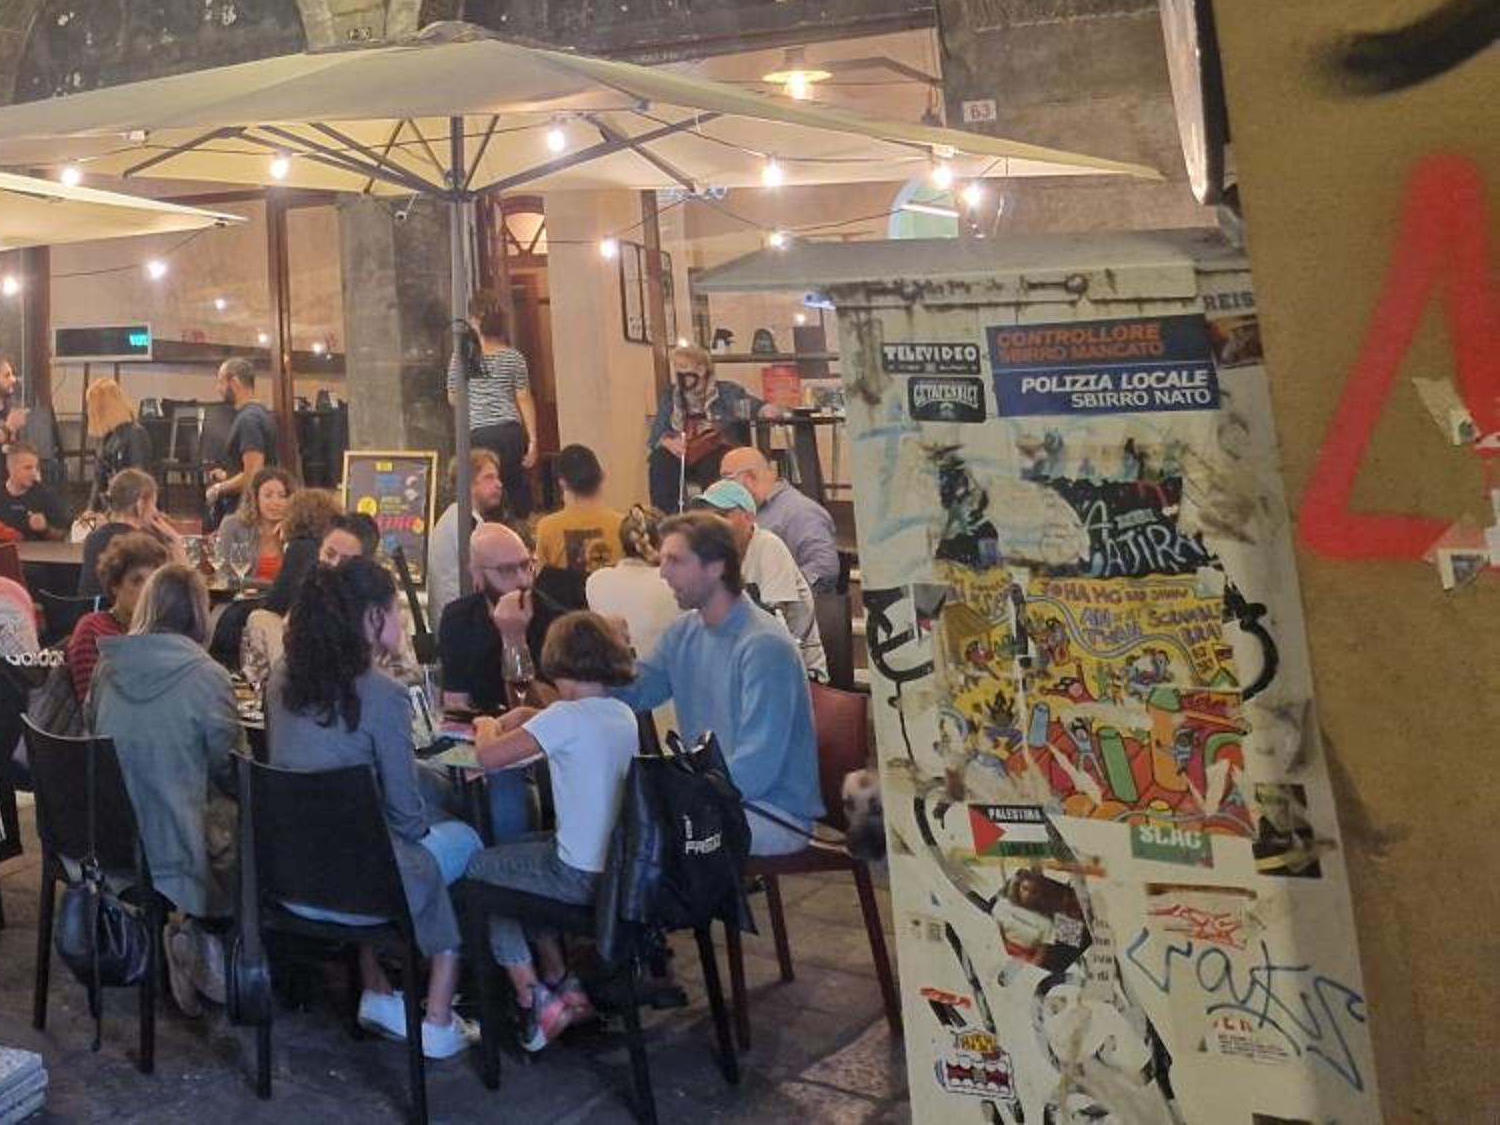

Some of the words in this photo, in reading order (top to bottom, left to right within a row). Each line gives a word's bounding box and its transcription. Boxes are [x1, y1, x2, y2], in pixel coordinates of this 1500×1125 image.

[996, 323, 1161, 348] CONTROLLORE
[883, 346, 977, 363] TELEVIDEO
[1021, 372, 1113, 395] POLIZIA
[1120, 369, 1209, 389] LOCALE
[1070, 390, 1150, 409] SBIRRO
[1154, 387, 1212, 406] NATO
[988, 807, 1042, 822] PALESTINA
